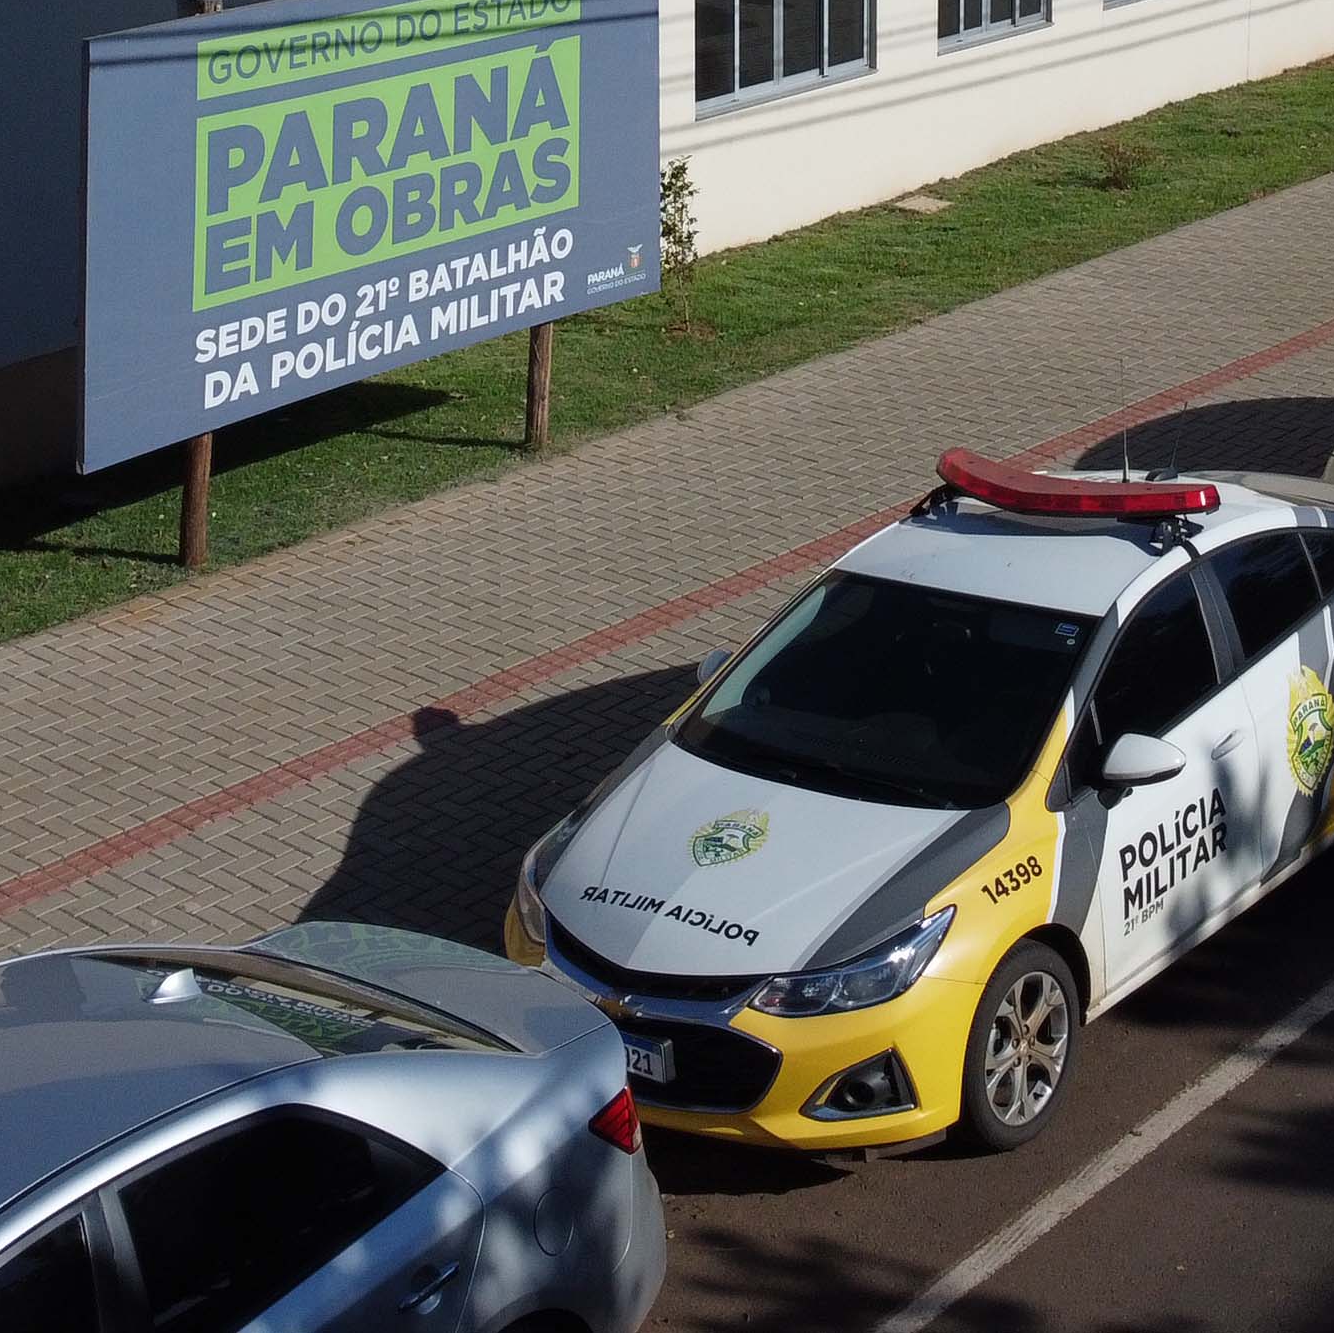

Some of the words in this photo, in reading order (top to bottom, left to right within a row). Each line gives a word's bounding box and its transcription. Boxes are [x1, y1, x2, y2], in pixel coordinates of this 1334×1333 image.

[208, 23, 383, 85] GOVERNO
[396, 4, 444, 41] DO
[207, 37, 571, 216] PARANÁ
[204, 201, 314, 296] EM
[334, 137, 571, 257] OBRAS
[194, 309, 291, 363] SEDE
[297, 293, 346, 333] DO
[409, 227, 573, 302] BATALHÃO
[587, 262, 625, 285] PARANÁ
[203, 364, 259, 409] DA
[271, 321, 420, 388] POLÍCIA
[430, 271, 565, 341] MILITAR
[981, 855, 1043, 905] 14398
[1118, 787, 1227, 882] POLÍCIA
[1123, 821, 1228, 920] MILITAR
[1141, 899, 1164, 924] BPM
